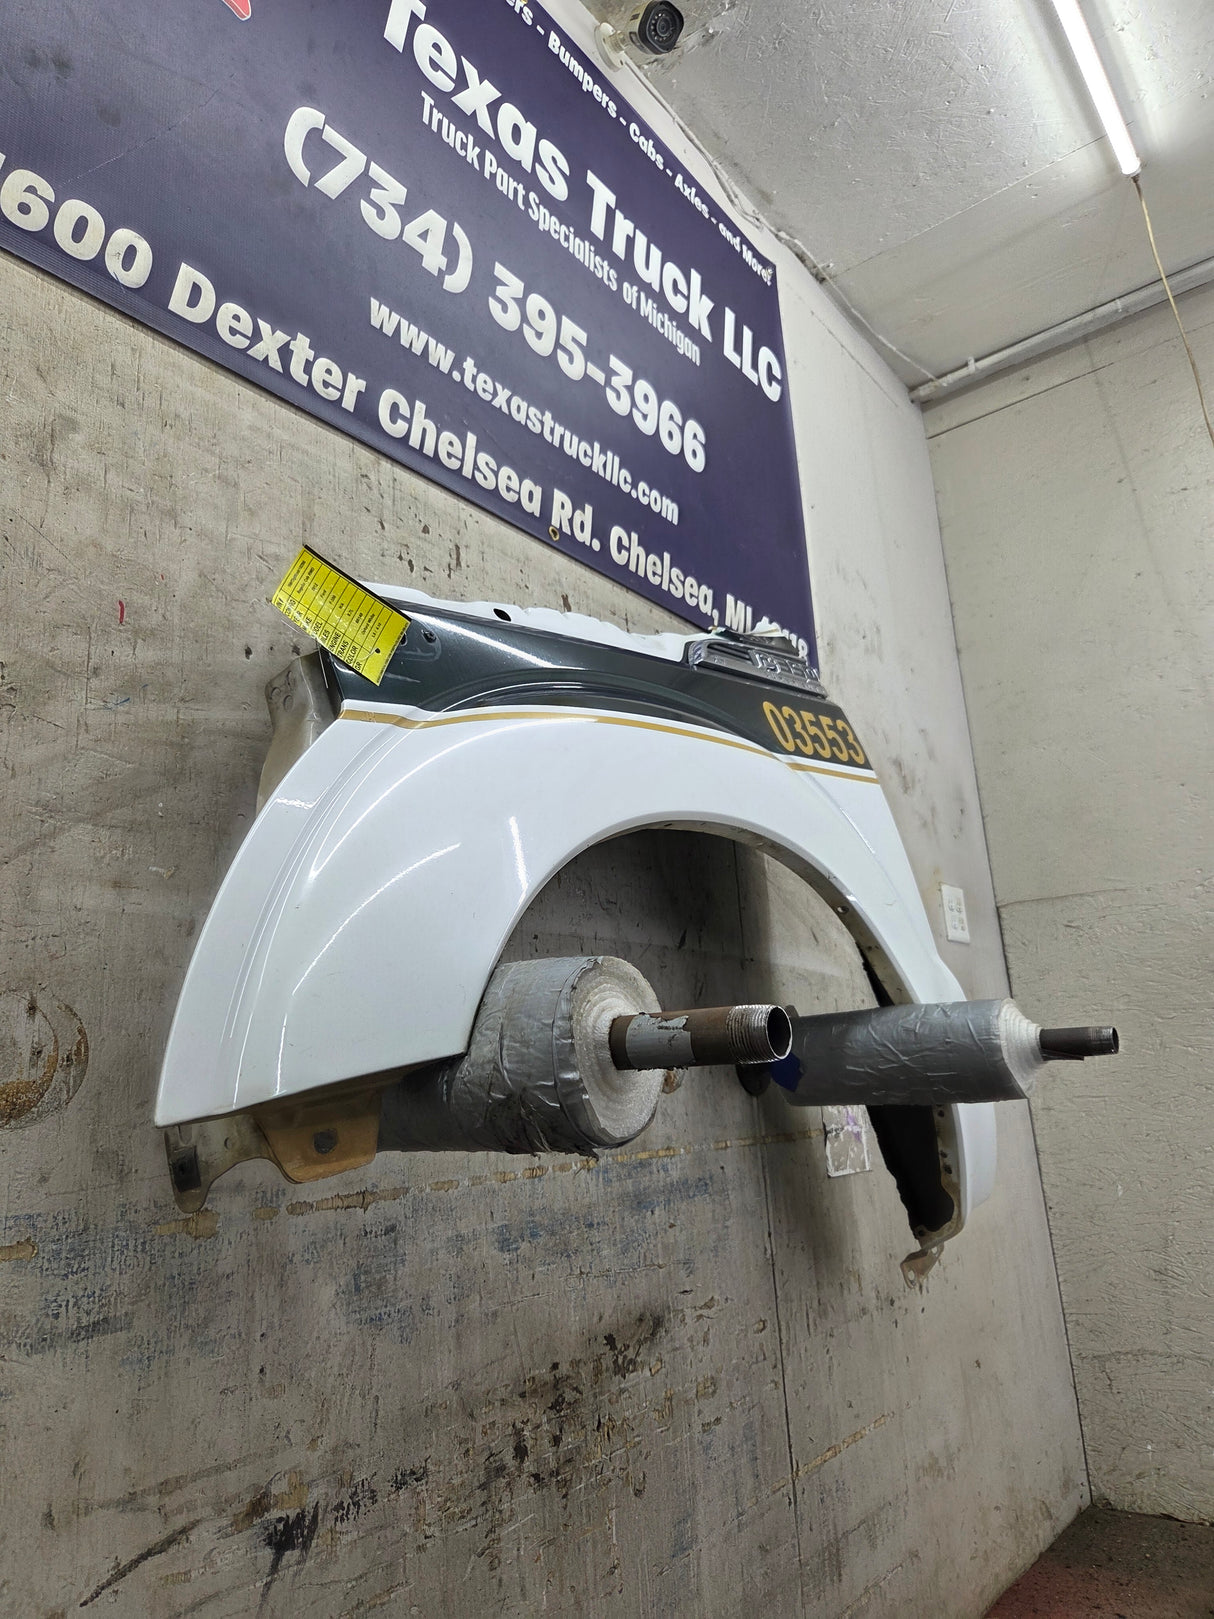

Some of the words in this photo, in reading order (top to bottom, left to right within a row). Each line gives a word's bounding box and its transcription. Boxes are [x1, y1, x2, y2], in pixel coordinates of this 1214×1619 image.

[384, 0, 570, 201] Texas
[587, 169, 715, 342] Truck
[723, 307, 782, 402] LLC
[420, 91, 480, 171] Truck
[484, 150, 526, 210] Part
[528, 191, 618, 291] Specialists
[622, 282, 639, 310] of
[640, 291, 700, 366] Michigan
[548, 31, 617, 119] Bumpers
[629, 122, 664, 170] Cabs
[674, 173, 709, 218] Axles
[719, 222, 741, 252] and
[0, 154, 153, 289] 600
[168, 263, 366, 413] Dexter
[378, 389, 542, 517] Chelsea
[551, 488, 601, 552] Rd.
[609, 525, 719, 626] Chelsea,
[725, 593, 752, 633] MI
[284, 106, 473, 294] (734)
[488, 262, 706, 473] 395-3966
[370, 297, 679, 525] www.texastruckllc.com
[762, 701, 865, 765] 03553
